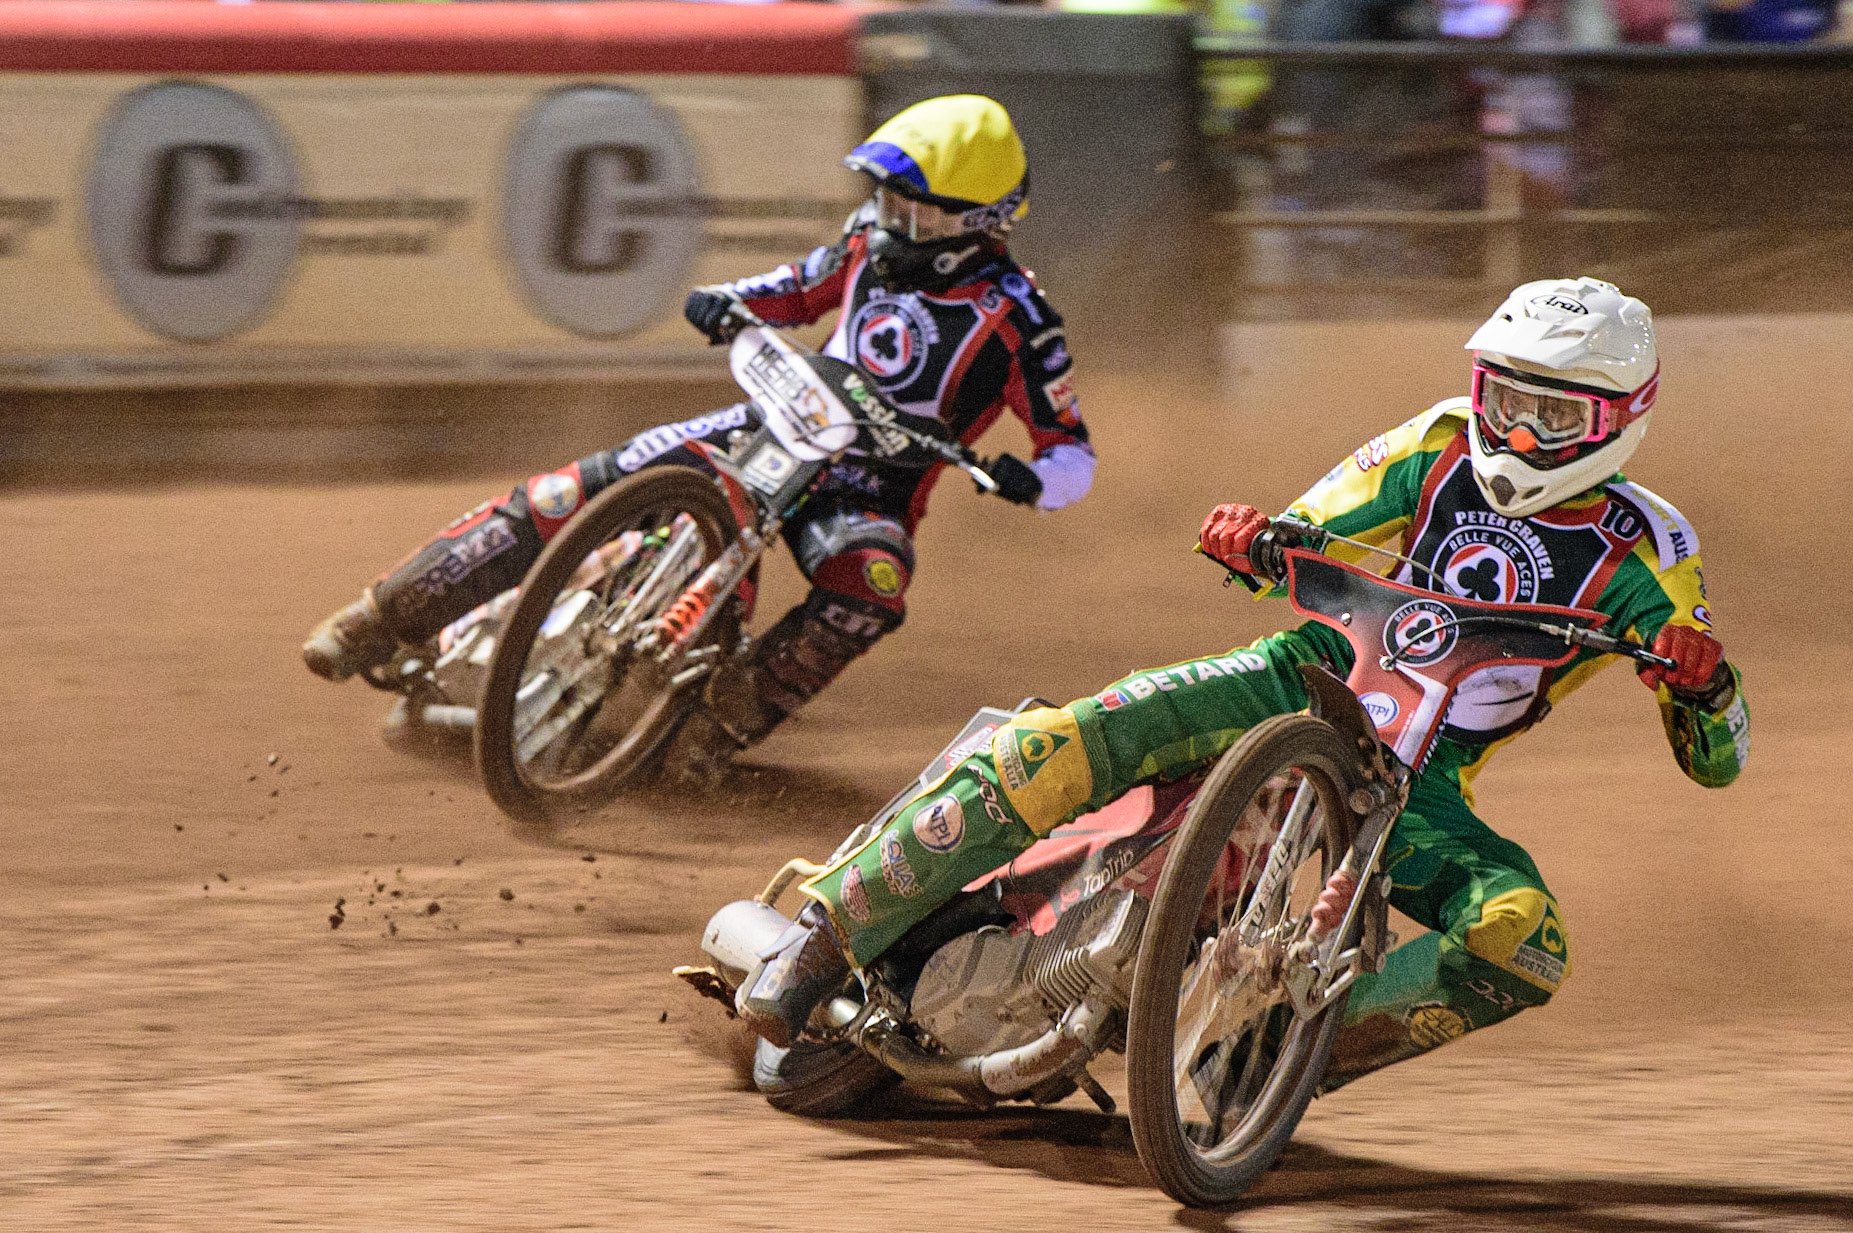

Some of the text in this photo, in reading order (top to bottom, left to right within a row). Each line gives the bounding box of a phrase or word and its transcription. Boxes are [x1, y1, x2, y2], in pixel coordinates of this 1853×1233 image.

[1544, 296, 1582, 313] Arai
[1454, 510, 1555, 580] PETER CRAVEN
[1598, 500, 1642, 541] 10
[1448, 532, 1532, 598] BELLE VUE ACES
[1393, 603, 1420, 622] BELLE
[1423, 603, 1443, 614] VUE
[1123, 652, 1267, 701] BETARD
[1083, 848, 1134, 897] TopTrip
